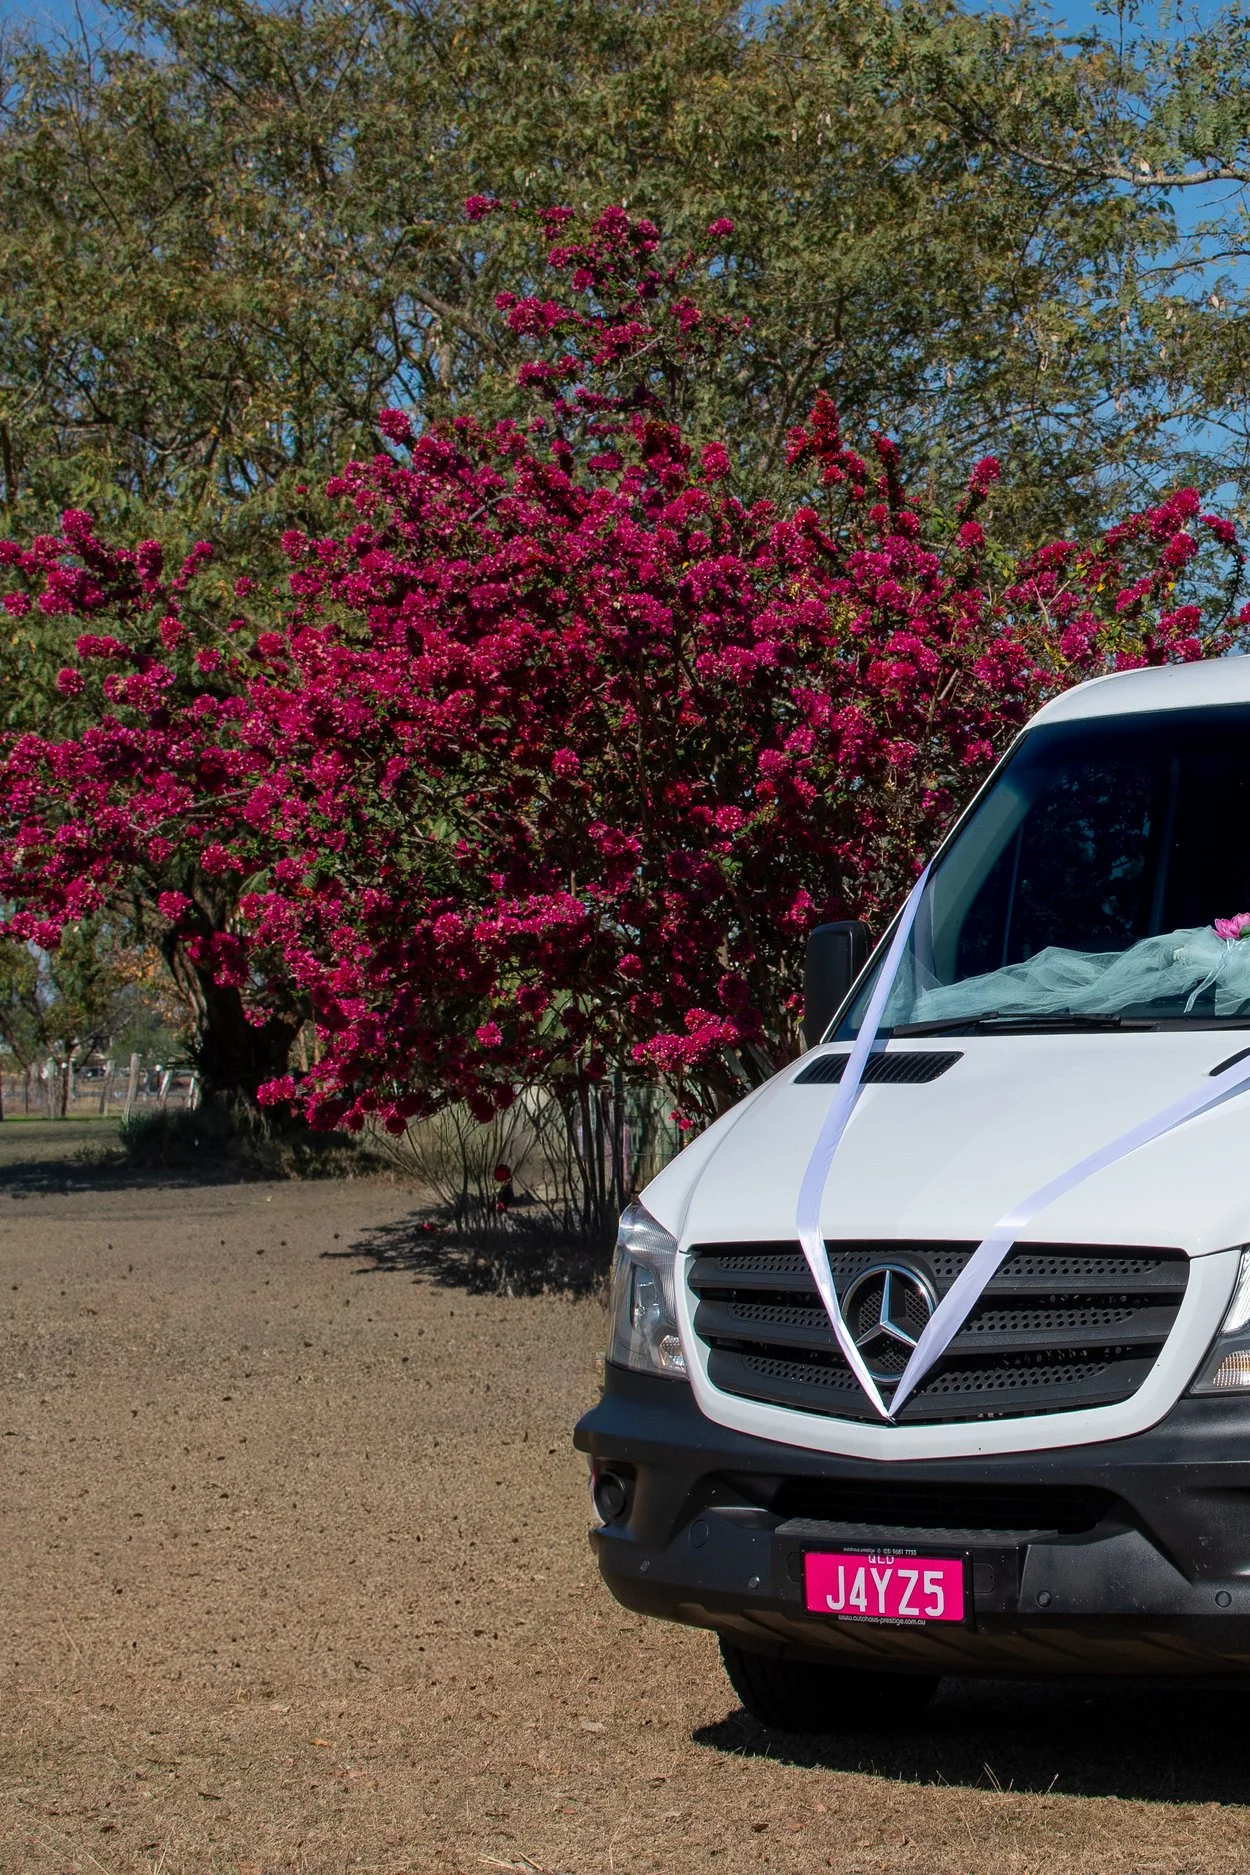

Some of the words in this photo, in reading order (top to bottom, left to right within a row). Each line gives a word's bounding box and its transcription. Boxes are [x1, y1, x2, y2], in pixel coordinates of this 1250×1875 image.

[868, 1555, 895, 1565] QLD
[826, 1565, 945, 1617] J4YZ5
[838, 1615, 926, 1626] www.autohaus-prestige.com.au
